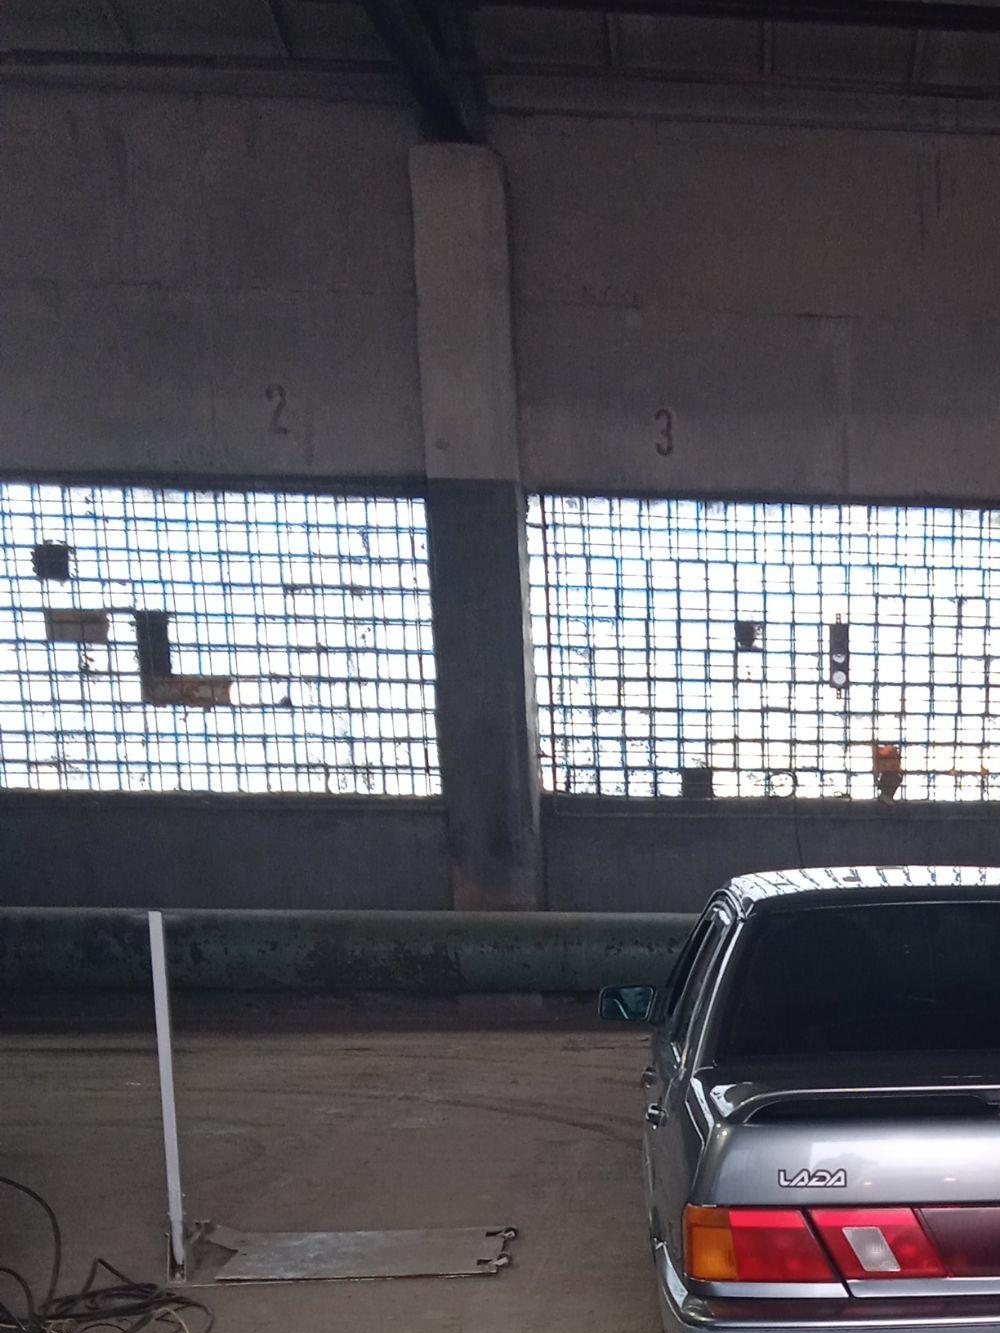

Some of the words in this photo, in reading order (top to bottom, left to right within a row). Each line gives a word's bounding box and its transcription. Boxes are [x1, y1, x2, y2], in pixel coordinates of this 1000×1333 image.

[264, 383, 289, 434] 2
[653, 408, 673, 456] 3
[778, 1168, 847, 1188] LADA
